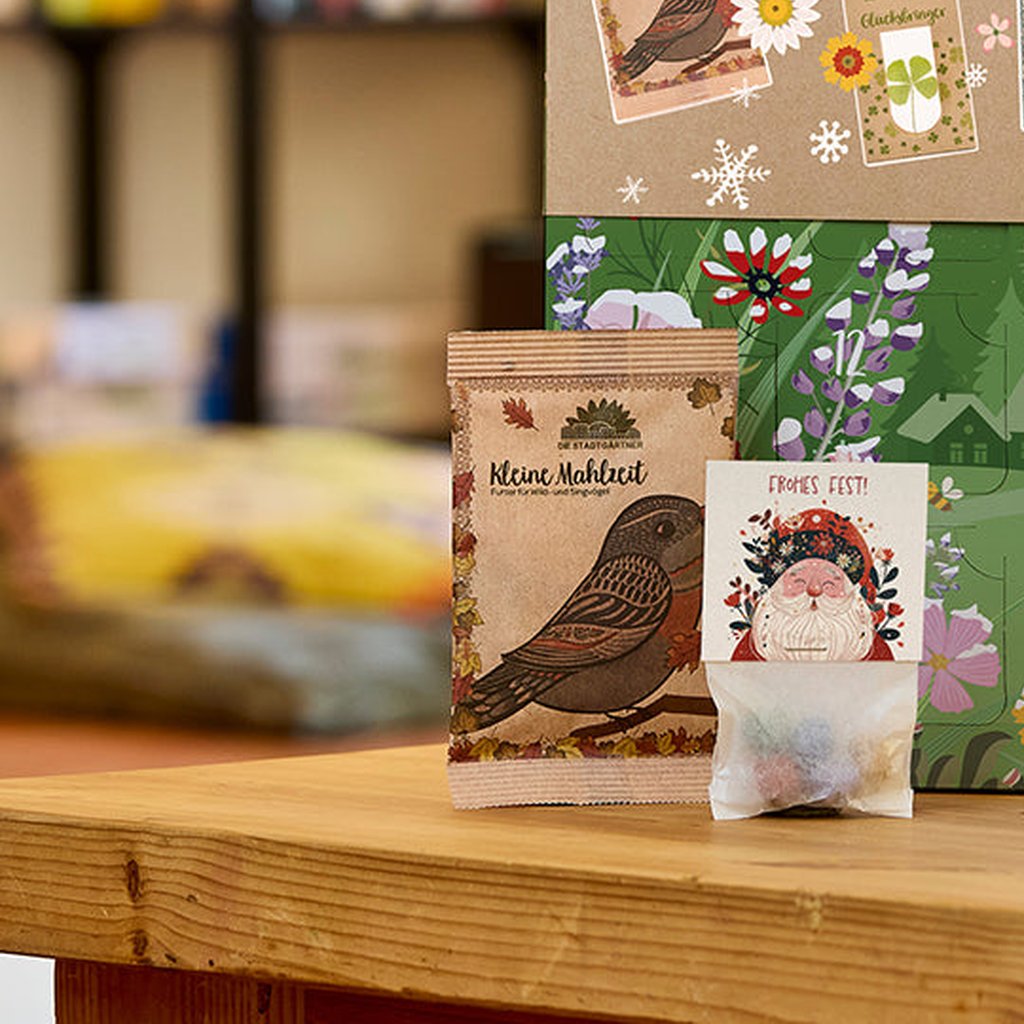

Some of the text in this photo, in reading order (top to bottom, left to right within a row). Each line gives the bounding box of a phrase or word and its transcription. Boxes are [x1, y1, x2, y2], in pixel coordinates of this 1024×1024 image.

[831, 329, 867, 377] 12
[557, 442, 571, 451] DIE
[490, 457, 648, 486] Kleine Mahlzeit
[768, 475, 868, 495] FROHES FEST!
